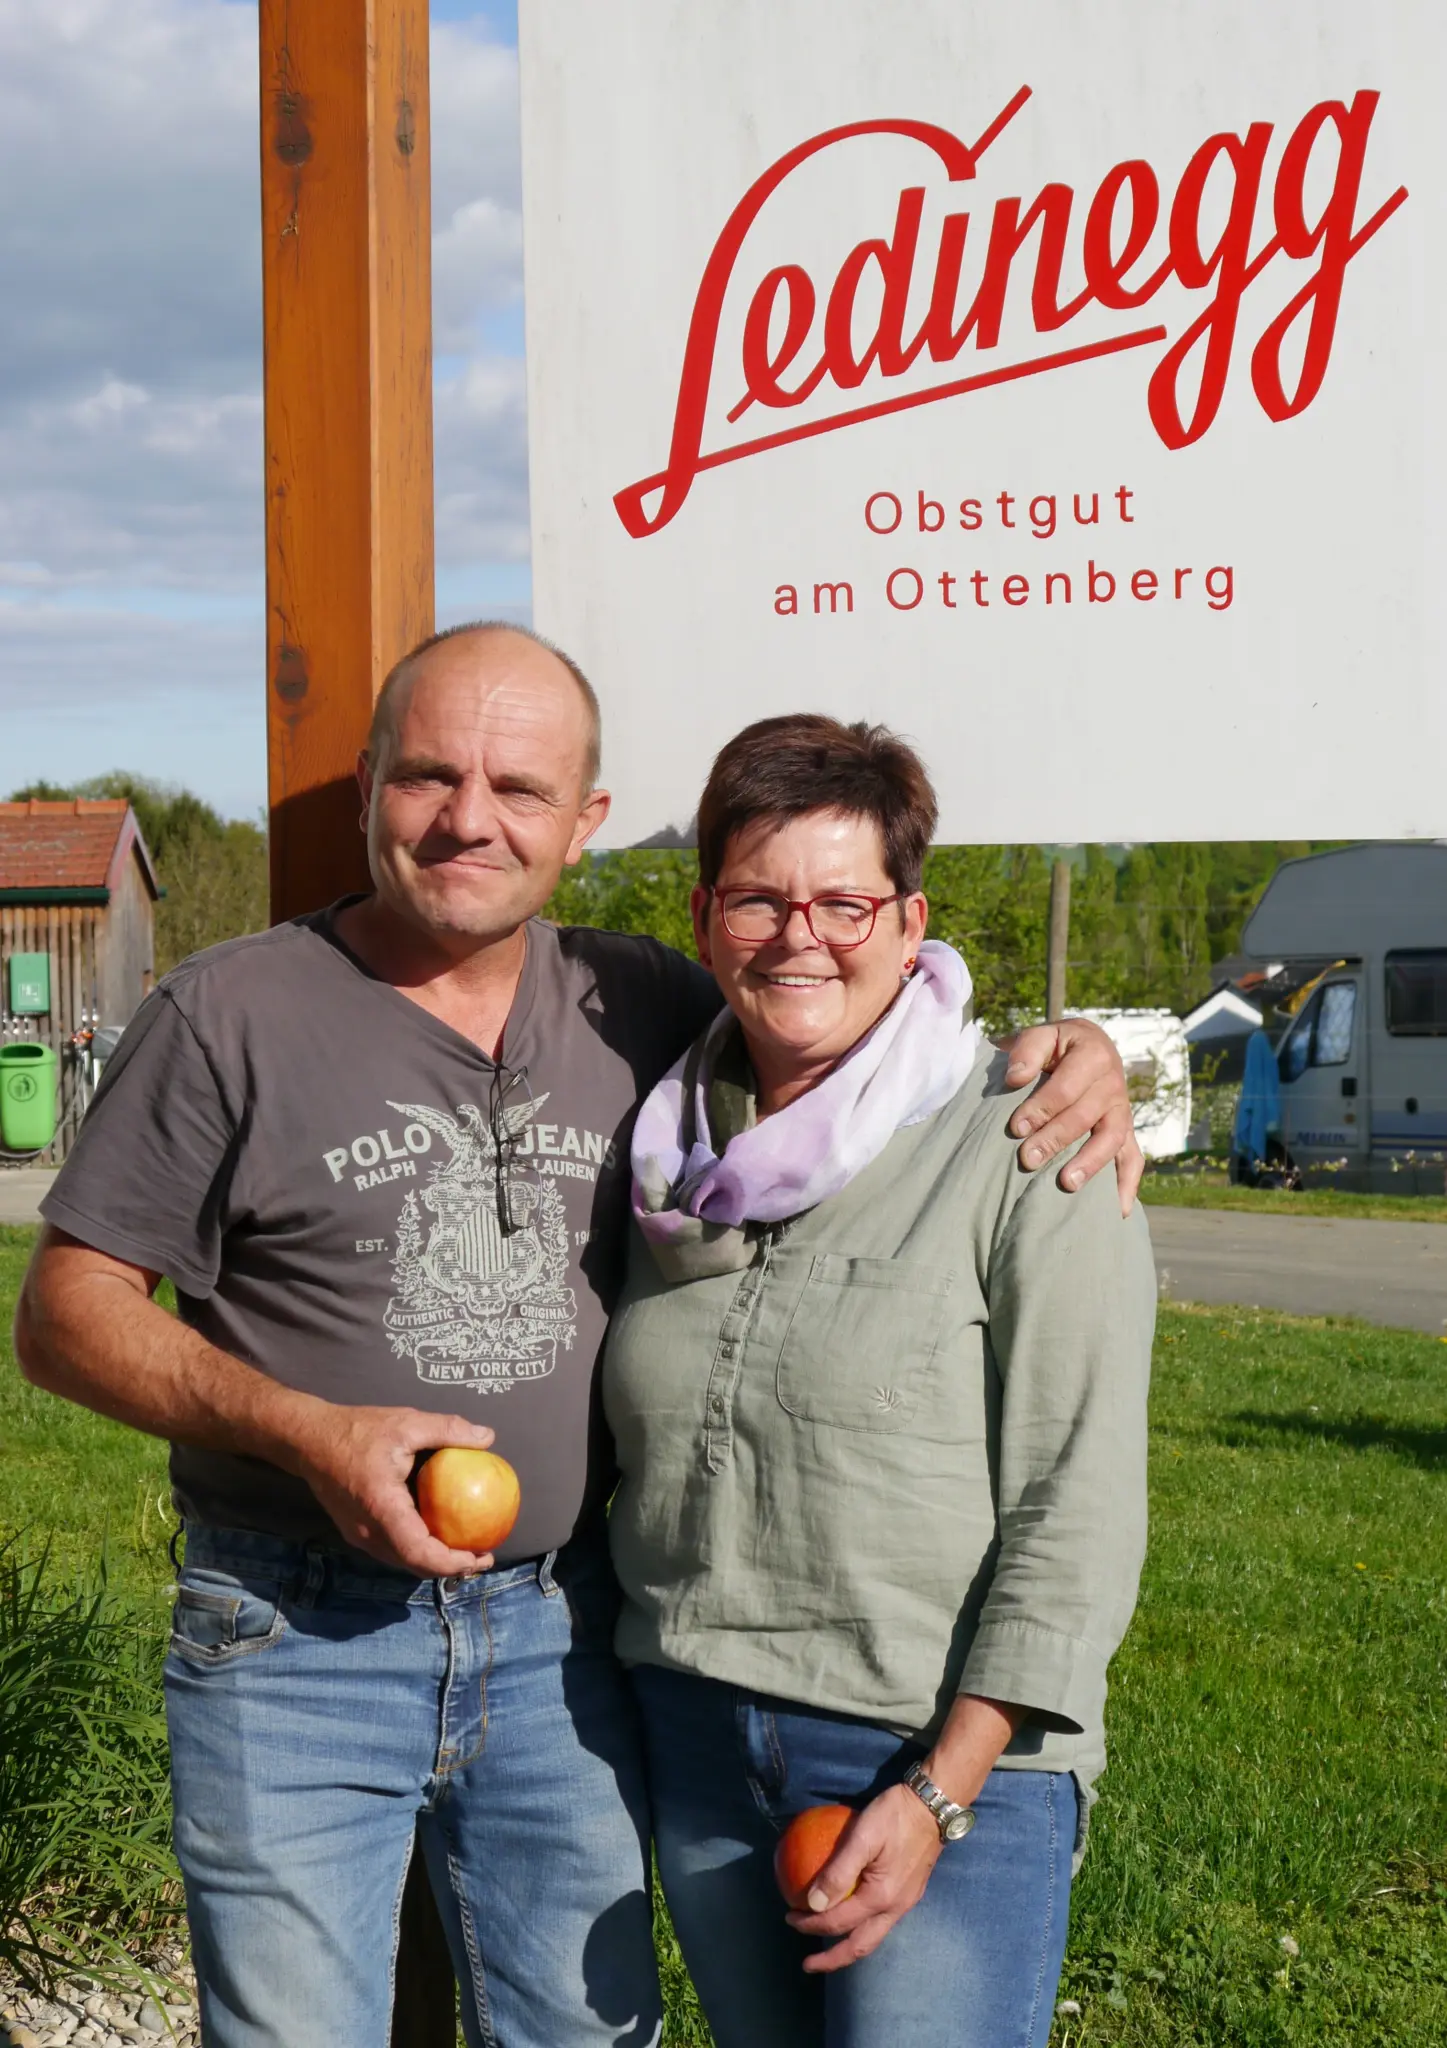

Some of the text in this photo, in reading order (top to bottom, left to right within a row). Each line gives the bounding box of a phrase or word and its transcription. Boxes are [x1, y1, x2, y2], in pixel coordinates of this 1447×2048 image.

[613, 84, 1409, 540] Ledinegg
[864, 485, 1135, 540] Obstgut
[774, 560, 1235, 616] am Ottenberg
[322, 1123, 617, 1183] POLO JEANS
[353, 1159, 595, 1191] RALPH LAUREN
[355, 1238, 389, 1253] EST.
[389, 1304, 570, 1326] AUTHENTIC ORIGINAL
[428, 1359, 547, 1380] NEW YORK CITY
